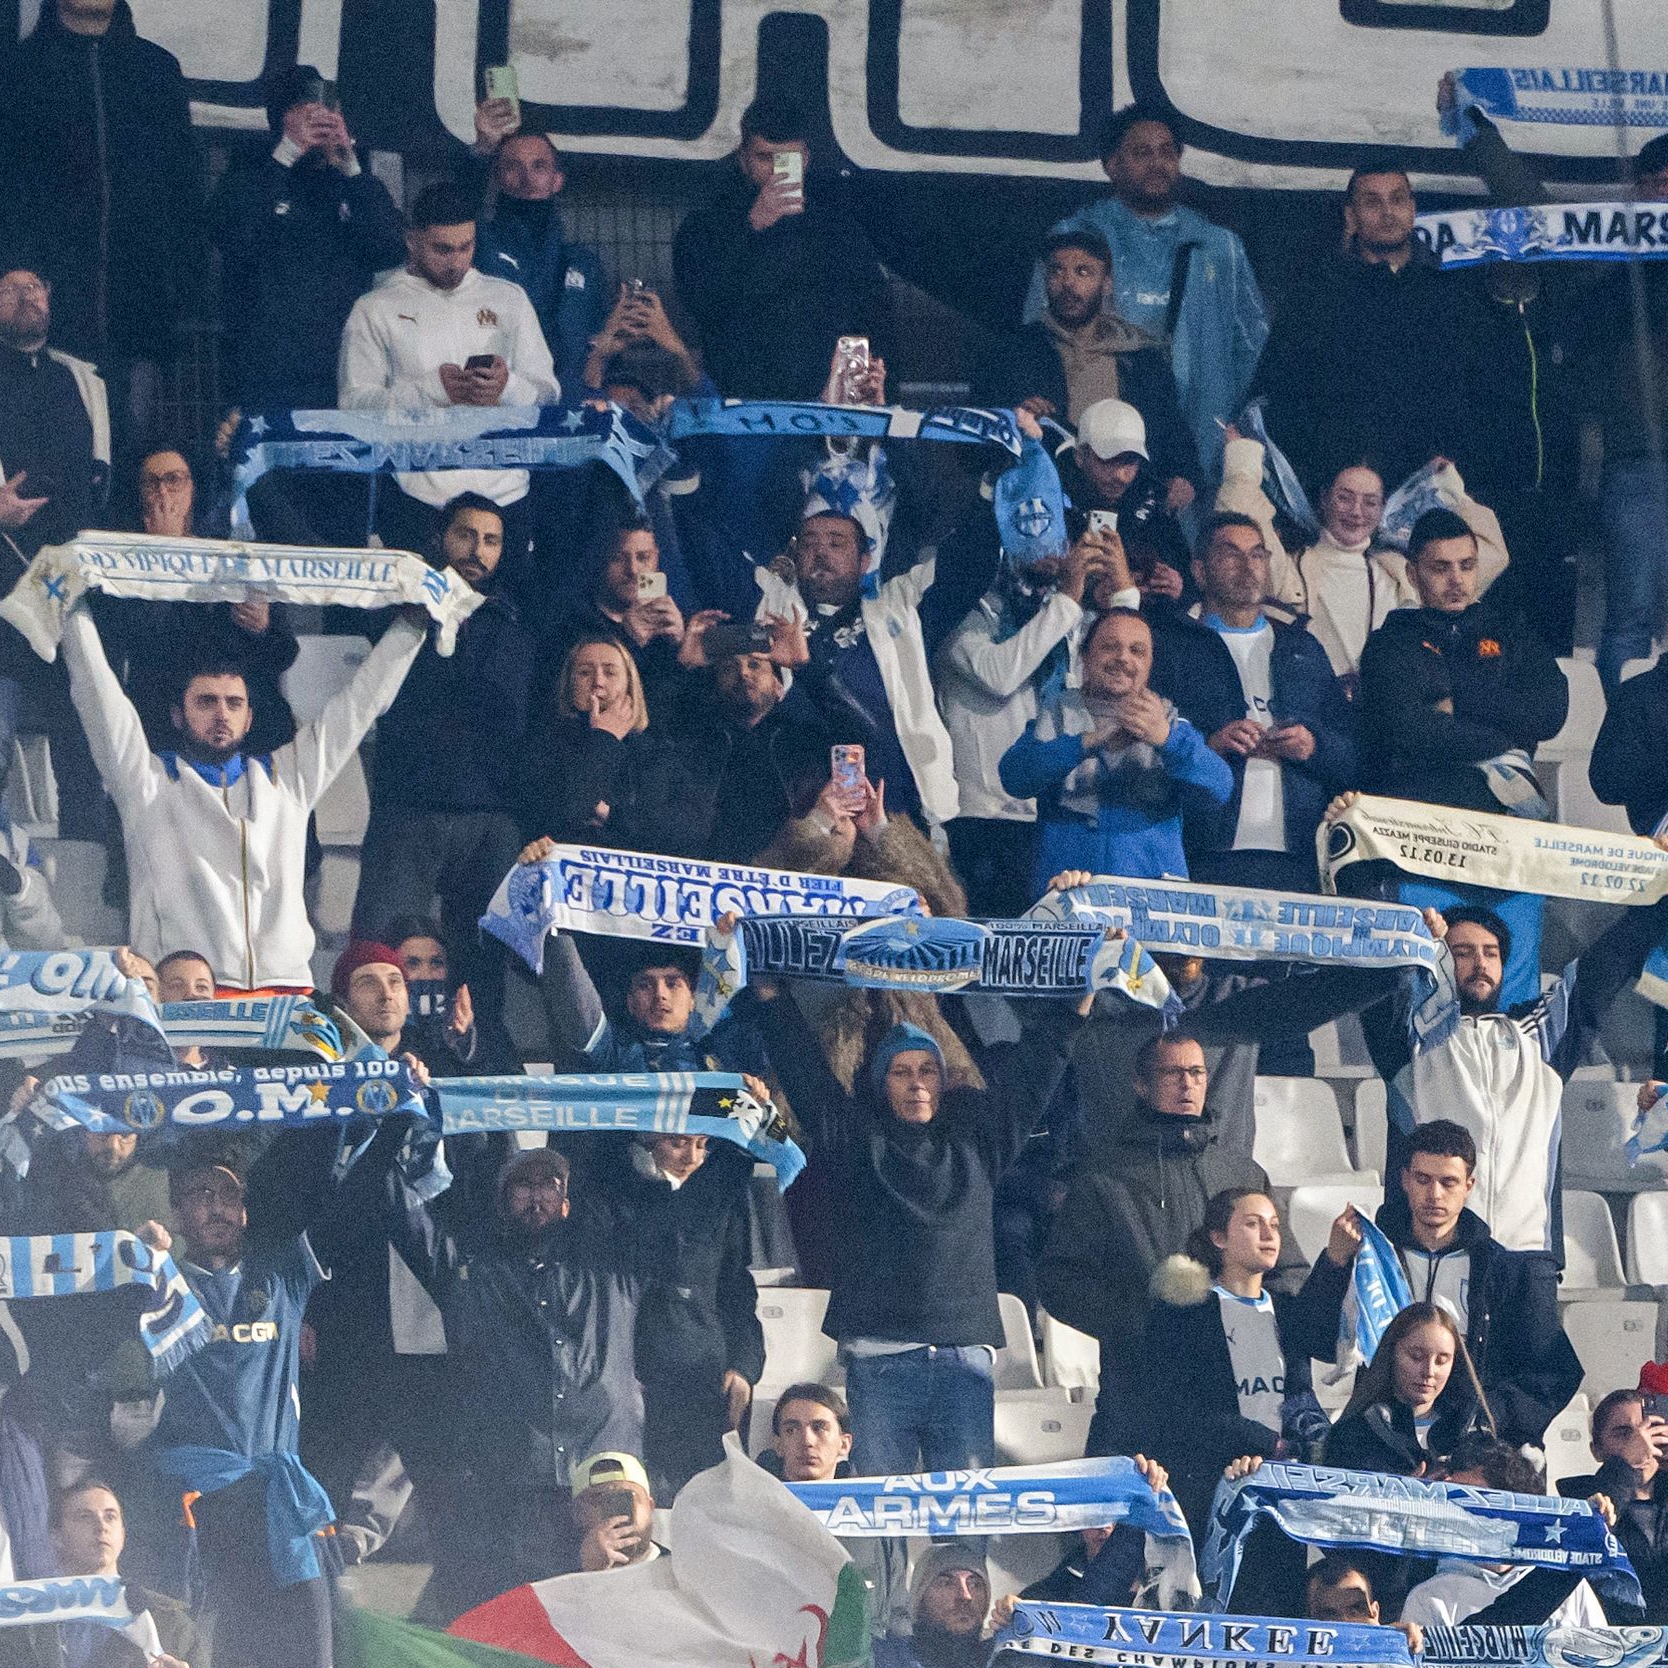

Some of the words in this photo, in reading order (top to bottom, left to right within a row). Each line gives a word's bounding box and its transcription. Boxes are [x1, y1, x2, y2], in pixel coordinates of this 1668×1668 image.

[78, 548, 219, 580] OLYMPIQUE
[259, 554, 396, 584] MARSEILLE
[580, 849, 712, 879] MARSEILLAIS
[798, 877, 843, 894] FIER
[981, 936, 1090, 987] MARSEILLE
[172, 1080, 355, 1124] O.M.
[883, 1466, 998, 1495] AUX
[824, 1490, 1058, 1537] ARMES
